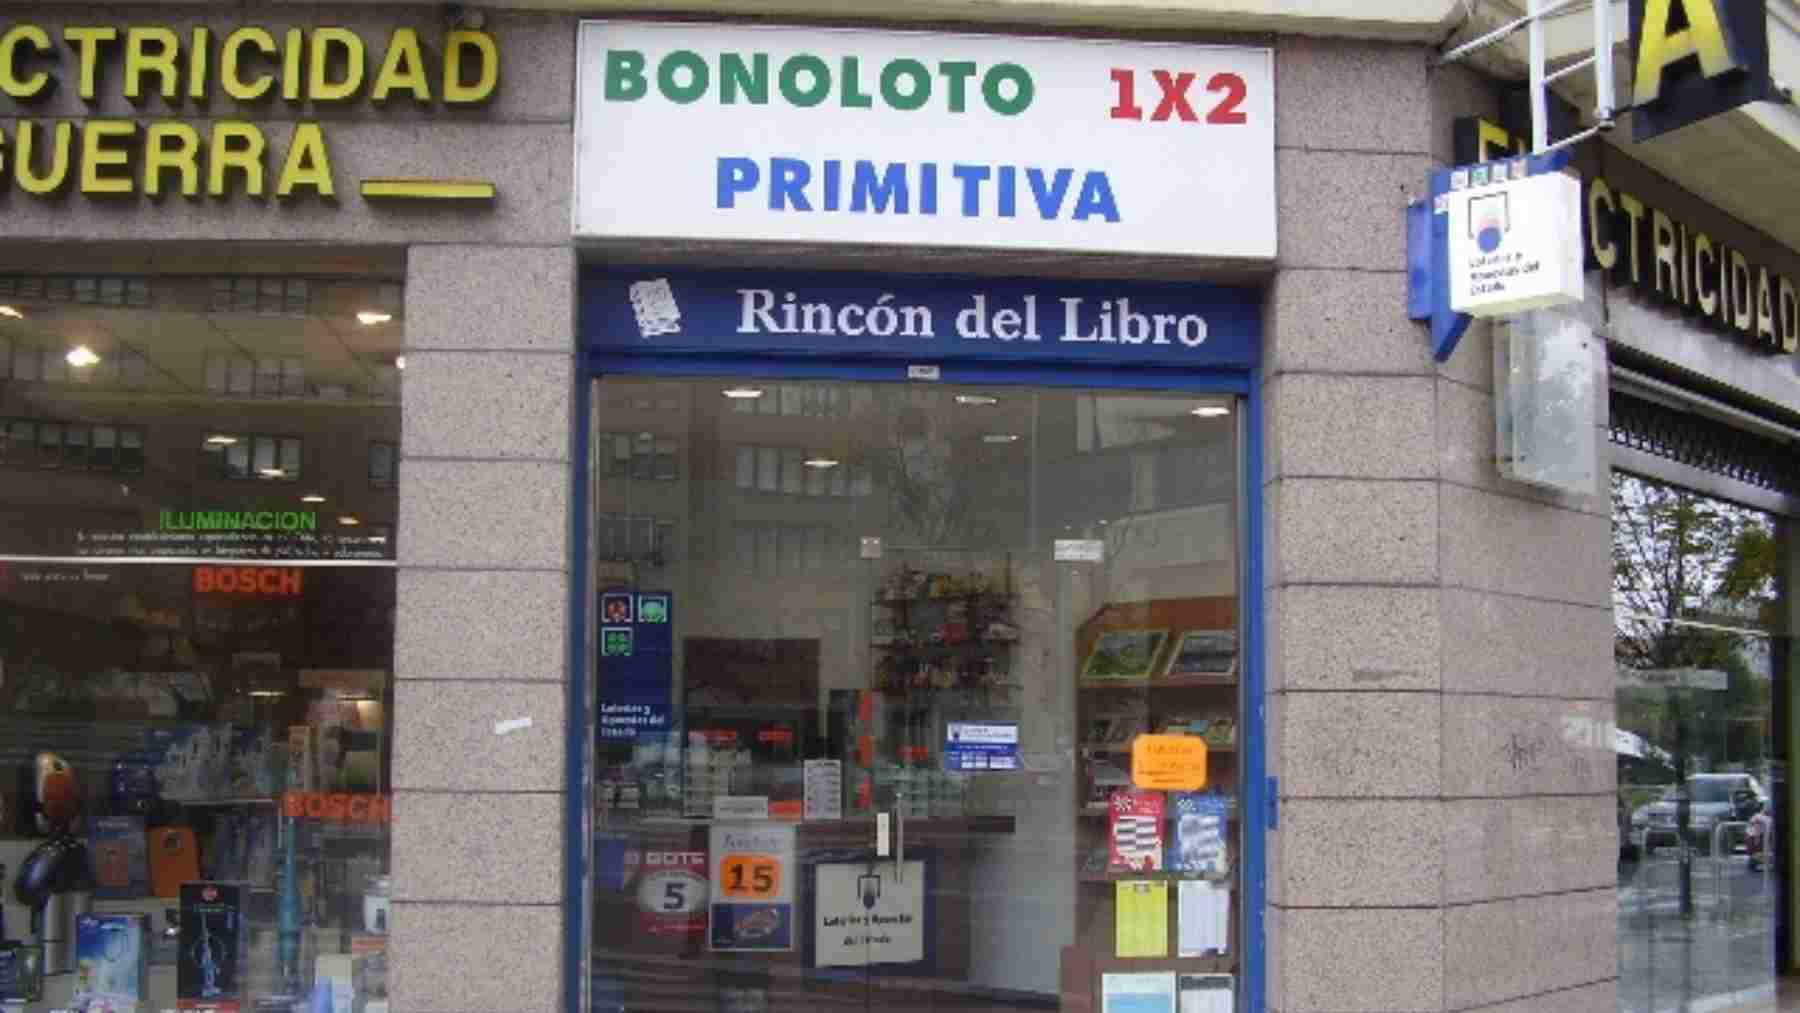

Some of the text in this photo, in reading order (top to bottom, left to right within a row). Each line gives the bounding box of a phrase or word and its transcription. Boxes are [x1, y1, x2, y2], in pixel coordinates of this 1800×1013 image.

[0, 25, 498, 102] CTRICIDAD
[604, 48, 1248, 125] BONOLOTO 1X2
[0, 120, 335, 196] UERRA
[715, 156, 1121, 223] PRIMITIVA
[736, 289, 1208, 347] Rincón del Libro
[160, 511, 316, 530] ILUMINACION
[195, 566, 302, 594] BOSCH
[664, 881, 688, 910] 5
[728, 863, 774, 893] 15
